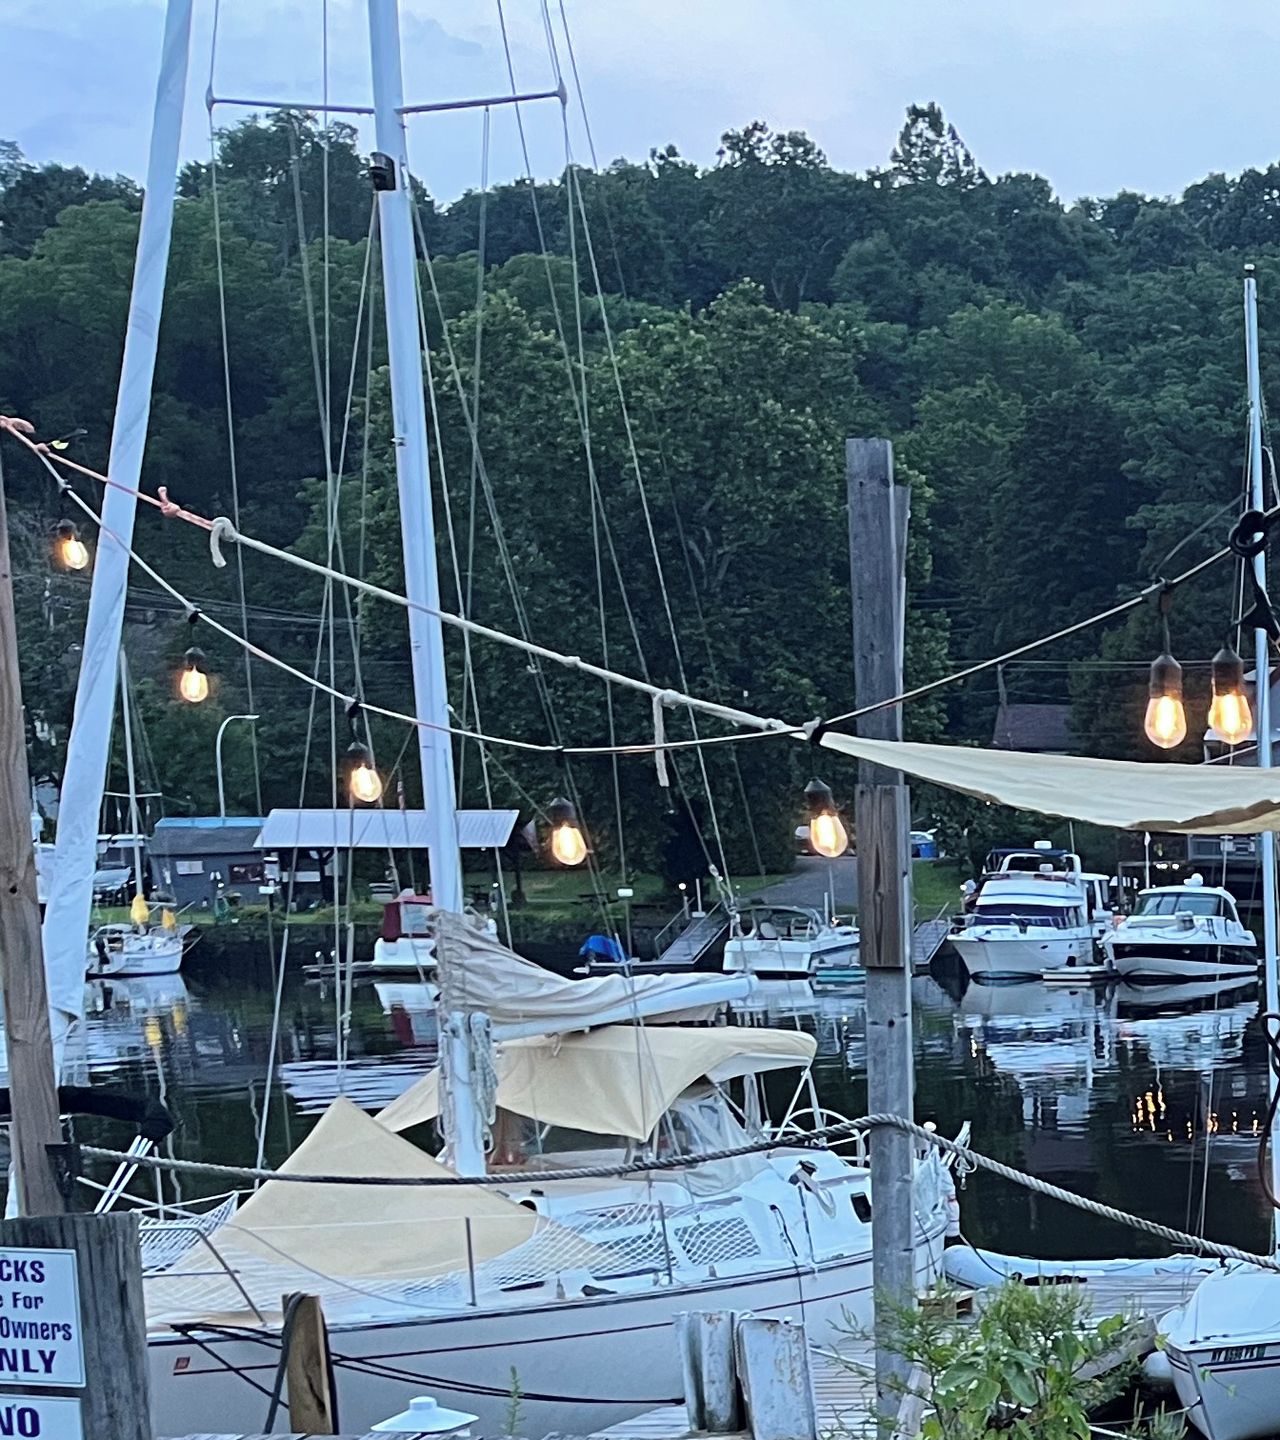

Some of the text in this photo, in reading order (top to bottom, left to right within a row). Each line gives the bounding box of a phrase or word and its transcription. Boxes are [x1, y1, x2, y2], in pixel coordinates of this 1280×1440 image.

[0, 1260, 46, 1284] CKS
[12, 1292, 44, 1310] For
[0, 1316, 73, 1341] Owners
